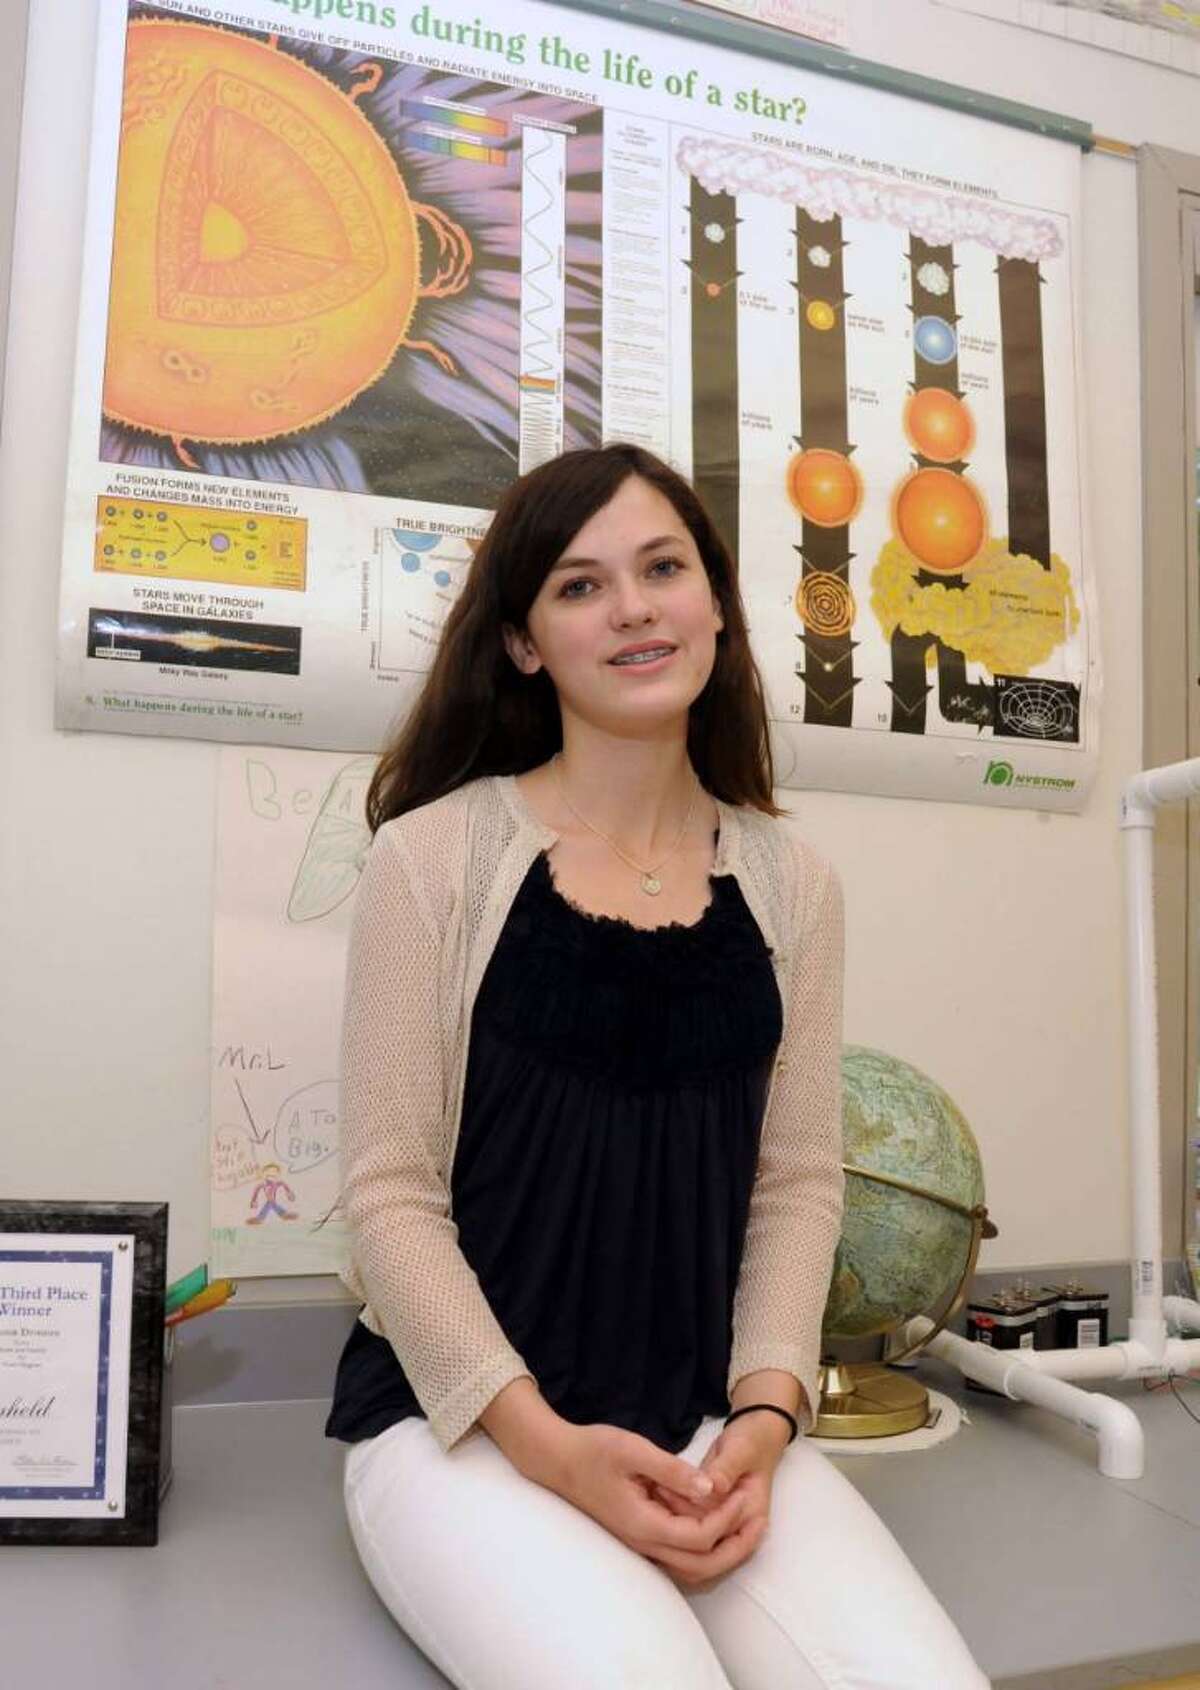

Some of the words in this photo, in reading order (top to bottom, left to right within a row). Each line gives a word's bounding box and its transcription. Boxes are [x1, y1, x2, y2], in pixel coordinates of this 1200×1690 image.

[184, 4, 211, 17] AND
[214, 12, 255, 27] OTHER
[258, 20, 294, 36] STARS
[298, 29, 324, 41] GIVE
[327, 35, 349, 46] OFF
[353, 40, 415, 62] PARTICLES
[418, 55, 439, 67] AND
[442, 62, 487, 79] RADIATE
[492, 71, 534, 88] ENERGY
[538, 82, 562, 95] INTO
[565, 87, 599, 102] SPACE
[411, 5, 528, 65] during
[539, 36, 591, 73] the
[602, 48, 653, 89] life
[665, 69, 698, 99] of
[707, 84, 723, 106] a
[734, 88, 807, 125] star?
[116, 472, 158, 486] FUSION
[161, 478, 200, 491] FORMS
[203, 483, 229, 494] NEW
[232, 486, 290, 502] ELEMENTS
[106, 484, 130, 495] AND
[133, 487, 189, 502] CHANGES
[191, 493, 222, 505] MASS
[225, 498, 251, 509] INTO
[254, 501, 299, 515] ENERGY
[396, 517, 426, 531] TRUE
[133, 588, 169, 600] STARS
[173, 592, 206, 604] MOVE
[208, 595, 264, 609] THROUGH
[142, 601, 180, 613] SPACE
[182, 604, 194, 614] IN
[197, 607, 254, 620] GALAXIES
[103, 696, 130, 707] What
[134, 698, 177, 711] happens
[1016, 773, 1076, 788] NYSTROM
[0, 1286, 42, 1301] Third
[48, 1286, 89, 1301] Place
